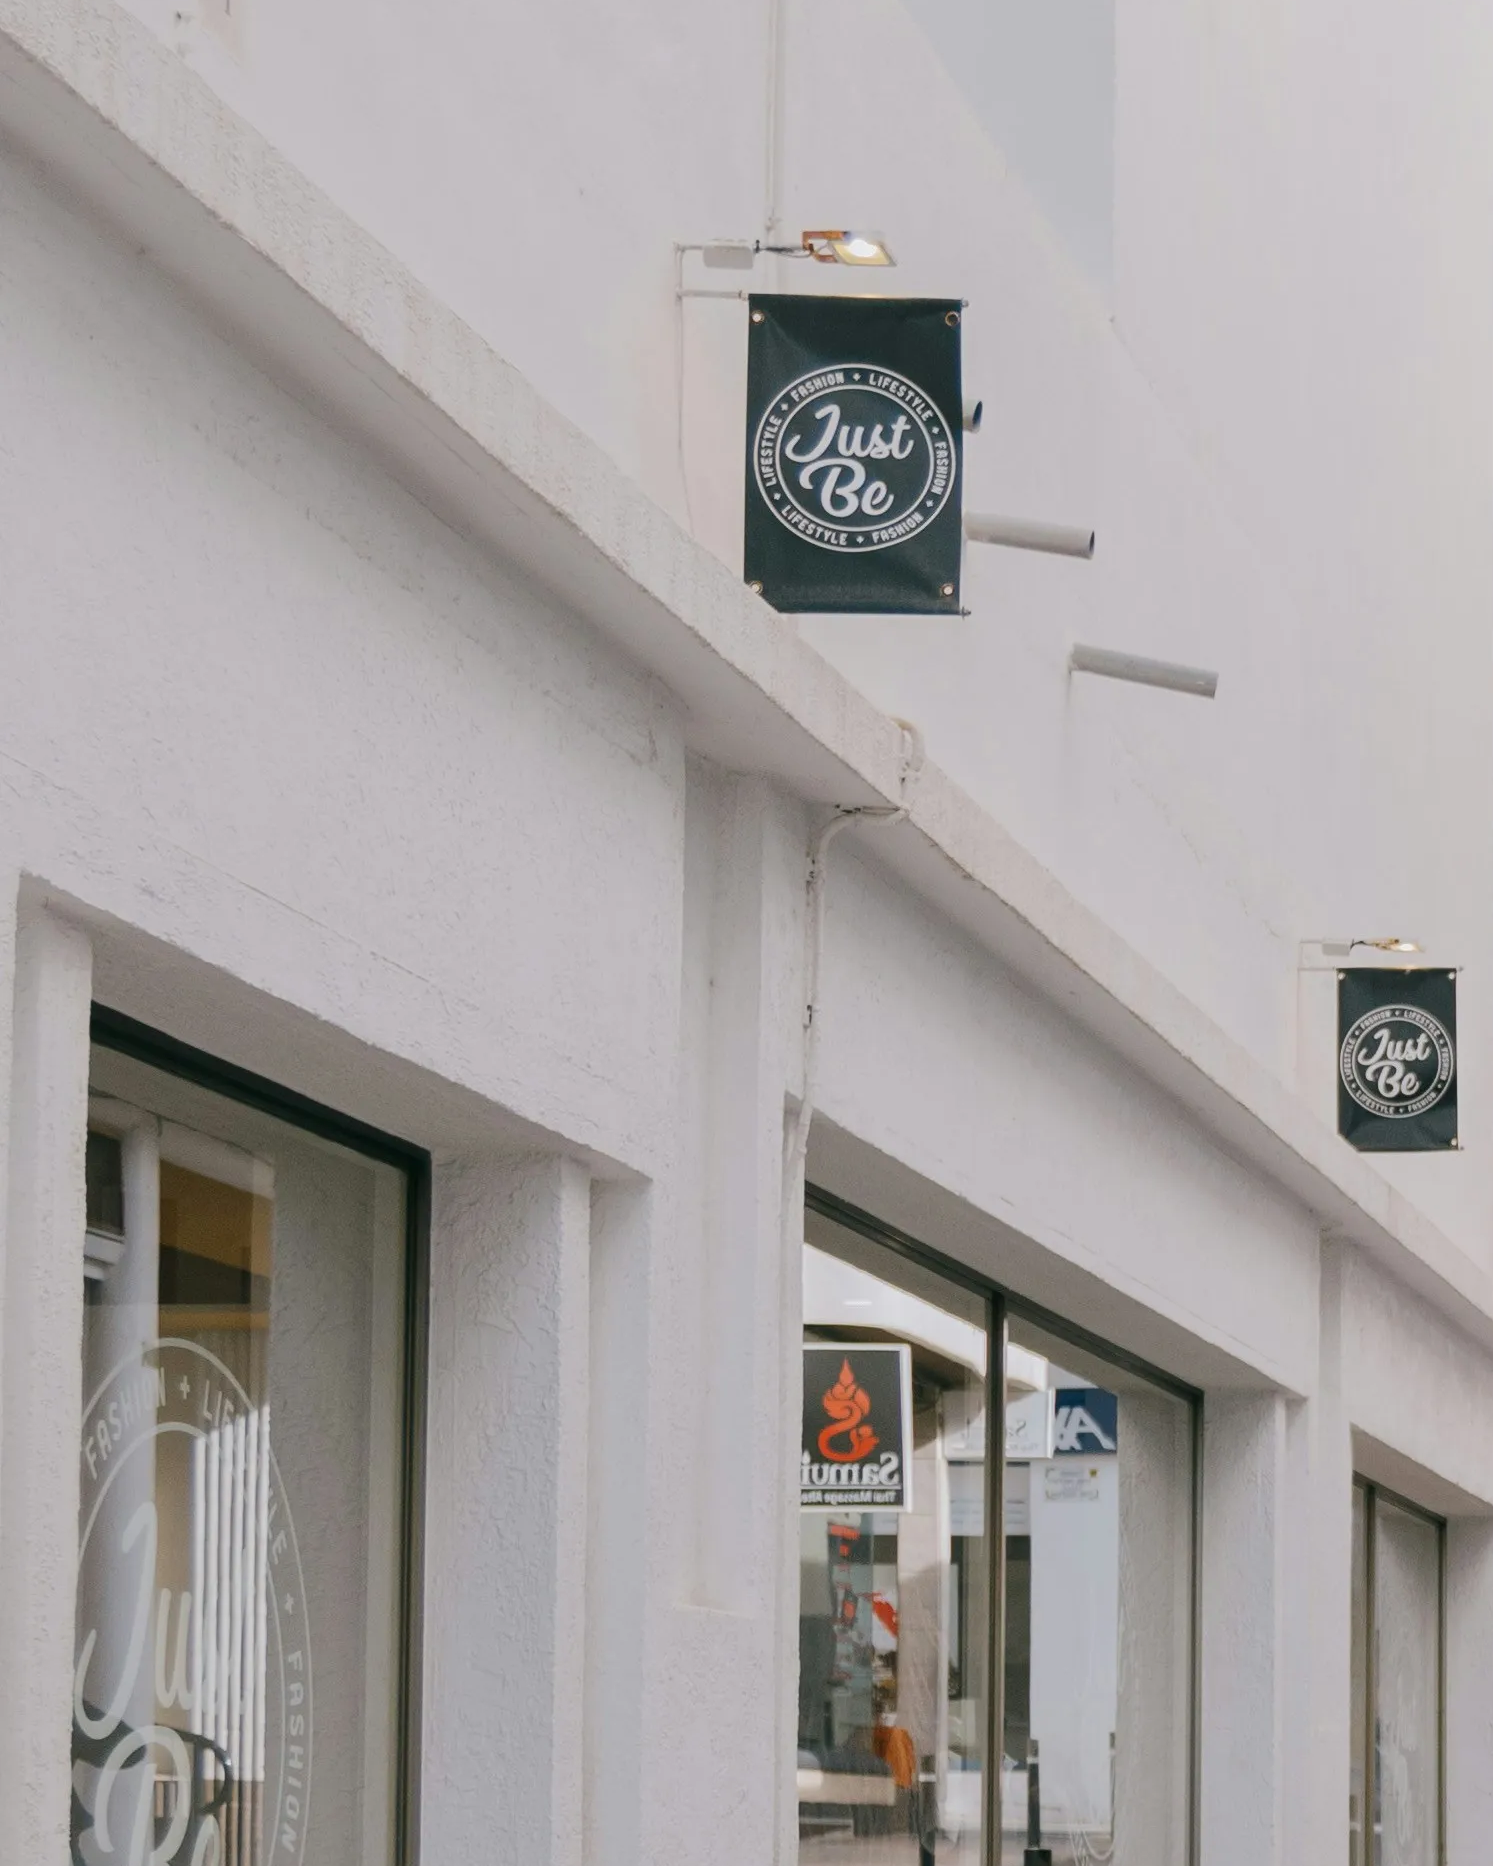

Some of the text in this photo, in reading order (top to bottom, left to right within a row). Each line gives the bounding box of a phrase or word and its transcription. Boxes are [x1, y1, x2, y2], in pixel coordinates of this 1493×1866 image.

[790, 372, 845, 402] FASHION
[869, 373, 934, 422] LIFESTYLE
[762, 416, 783, 488] LIFESTYLE
[785, 403, 915, 463] Just
[800, 458, 895, 518] Be
[933, 441, 949, 495] FASHION
[781, 505, 848, 546] LIFESTYLE
[872, 512, 924, 544] FASHION
[1357, 1028, 1431, 1066] Just
[1365, 1061, 1420, 1098] Be
[84, 1367, 167, 1481] FASHION
[281, 1650, 305, 1854] FASHION
